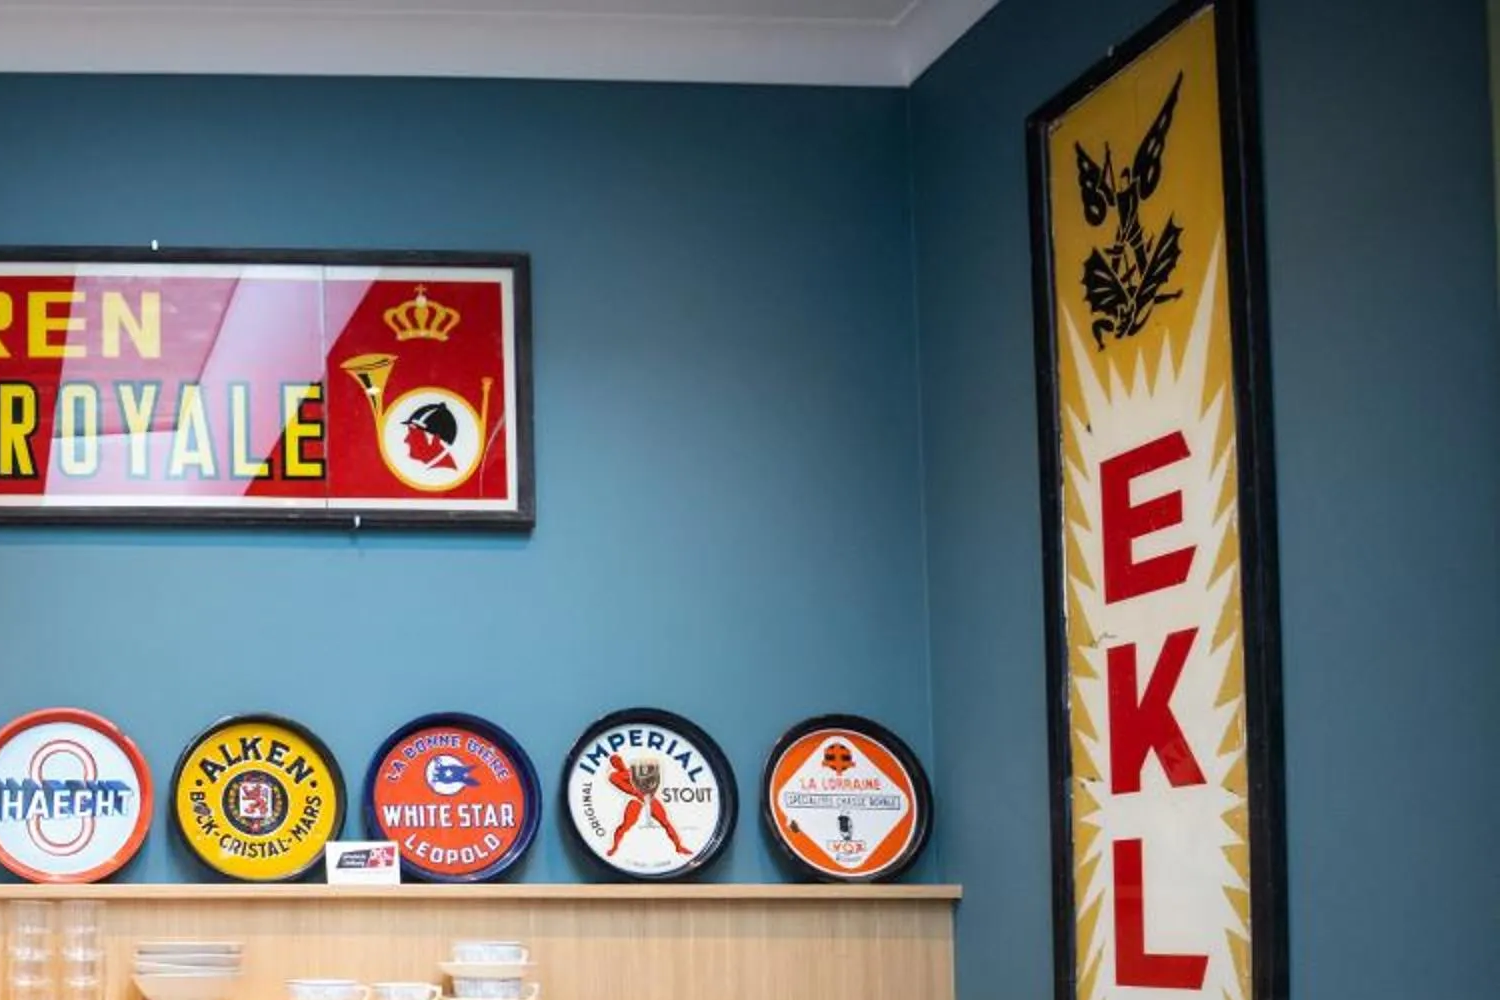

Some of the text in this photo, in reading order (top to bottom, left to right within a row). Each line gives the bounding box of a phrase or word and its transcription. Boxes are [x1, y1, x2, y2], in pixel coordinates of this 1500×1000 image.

[199, 737, 314, 785] ALKEN
[387, 760, 406, 781] LA
[403, 735, 461, 760] BONNE
[579, 730, 704, 783] IMPERIAL
[662, 787, 712, 803] STOUT
[800, 777, 881, 791] LA LORRAINE
[383, 804, 516, 828] WHITE STAR
[582, 782, 606, 837] ORIGINAL
[404, 833, 501, 865] LEOPOLD
